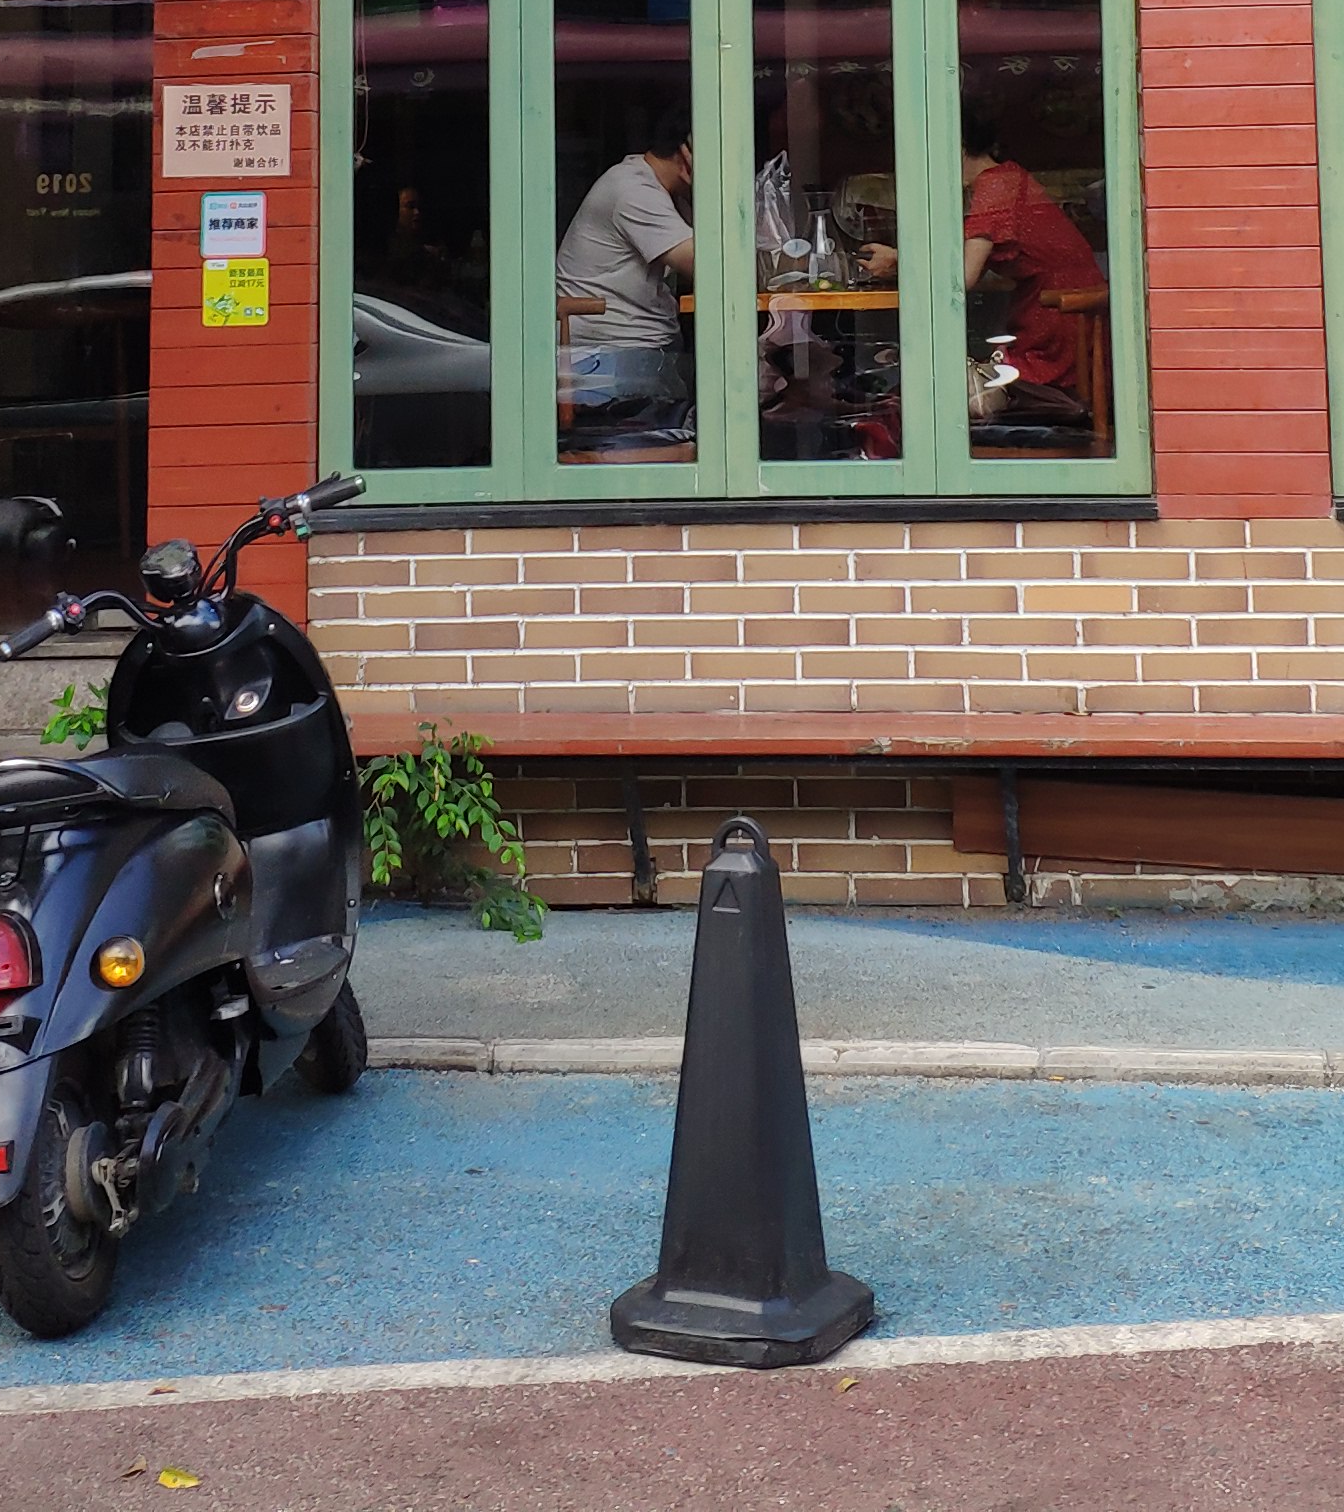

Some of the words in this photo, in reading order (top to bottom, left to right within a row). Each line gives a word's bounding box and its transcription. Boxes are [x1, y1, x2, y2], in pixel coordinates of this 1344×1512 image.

[182, 93, 276, 115] 温馨提示
[175, 124, 281, 136] 本店禁止自带饮品
[175, 139, 255, 151] 及不能打扑克
[209, 218, 258, 230] 推荐商家
